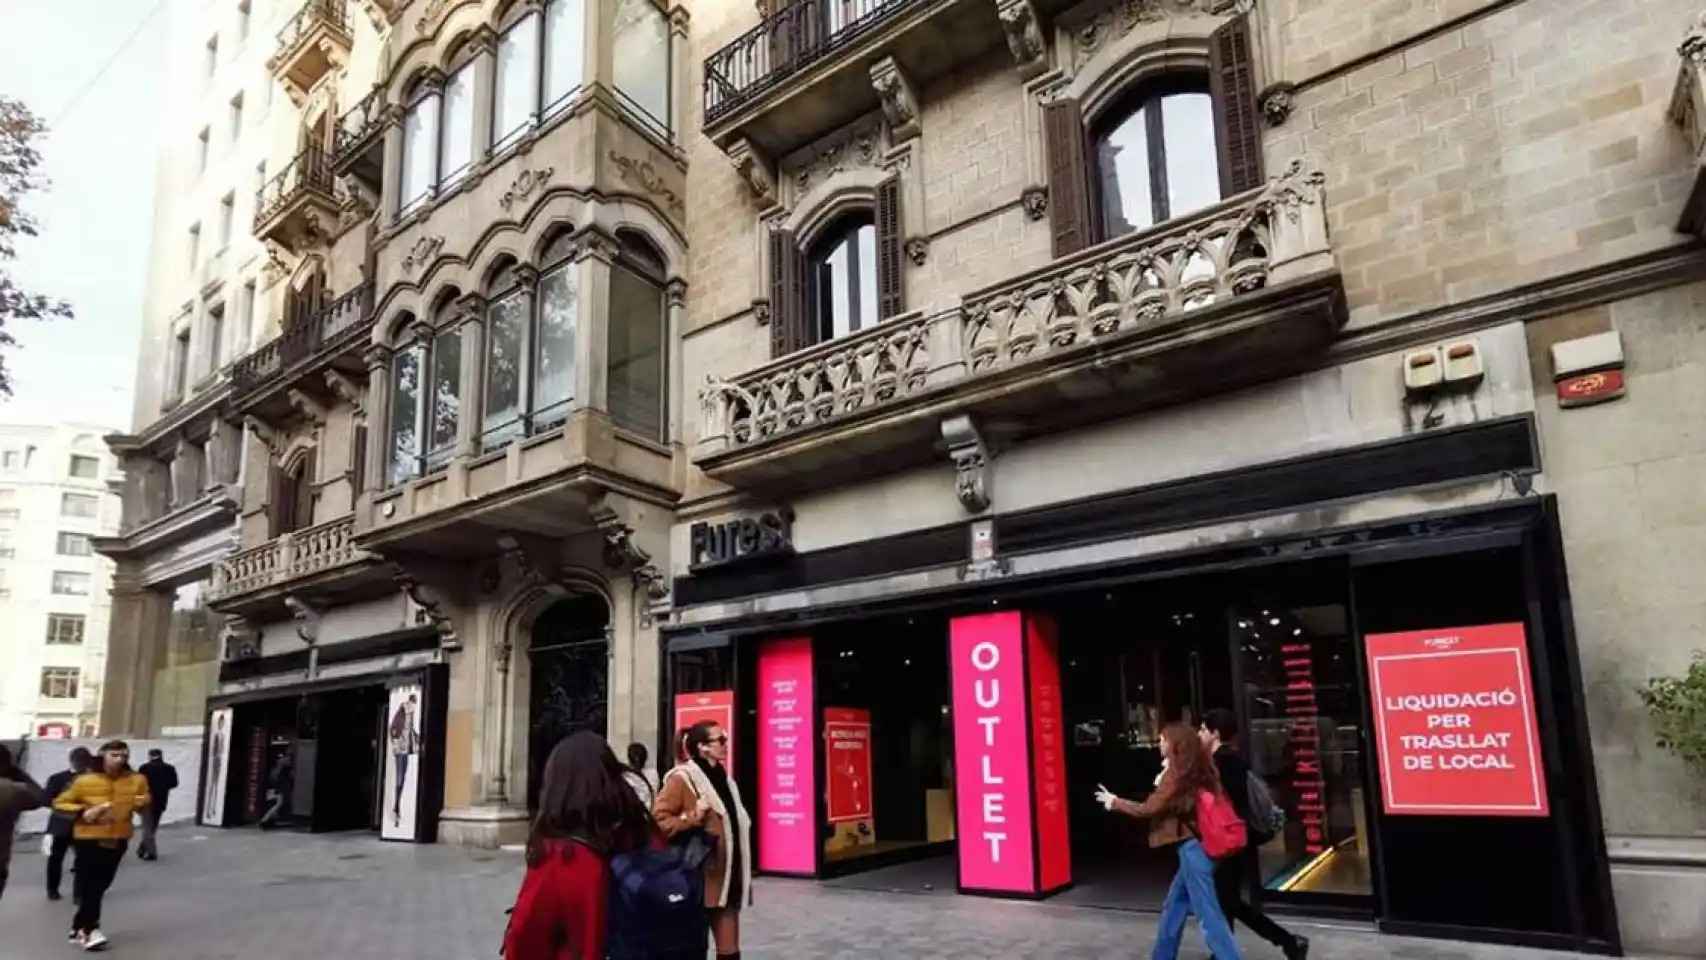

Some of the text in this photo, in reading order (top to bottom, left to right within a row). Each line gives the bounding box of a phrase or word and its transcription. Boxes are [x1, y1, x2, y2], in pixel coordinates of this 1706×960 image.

[691, 507, 796, 566] Furest
[1386, 687, 1516, 711] LIQUIDACIÓ
[1427, 714, 1471, 728] PER
[1400, 733, 1511, 749] TRASLLAT
[971, 642, 1008, 863] OUTLET
[1403, 754, 1515, 770] DE LOCAL
